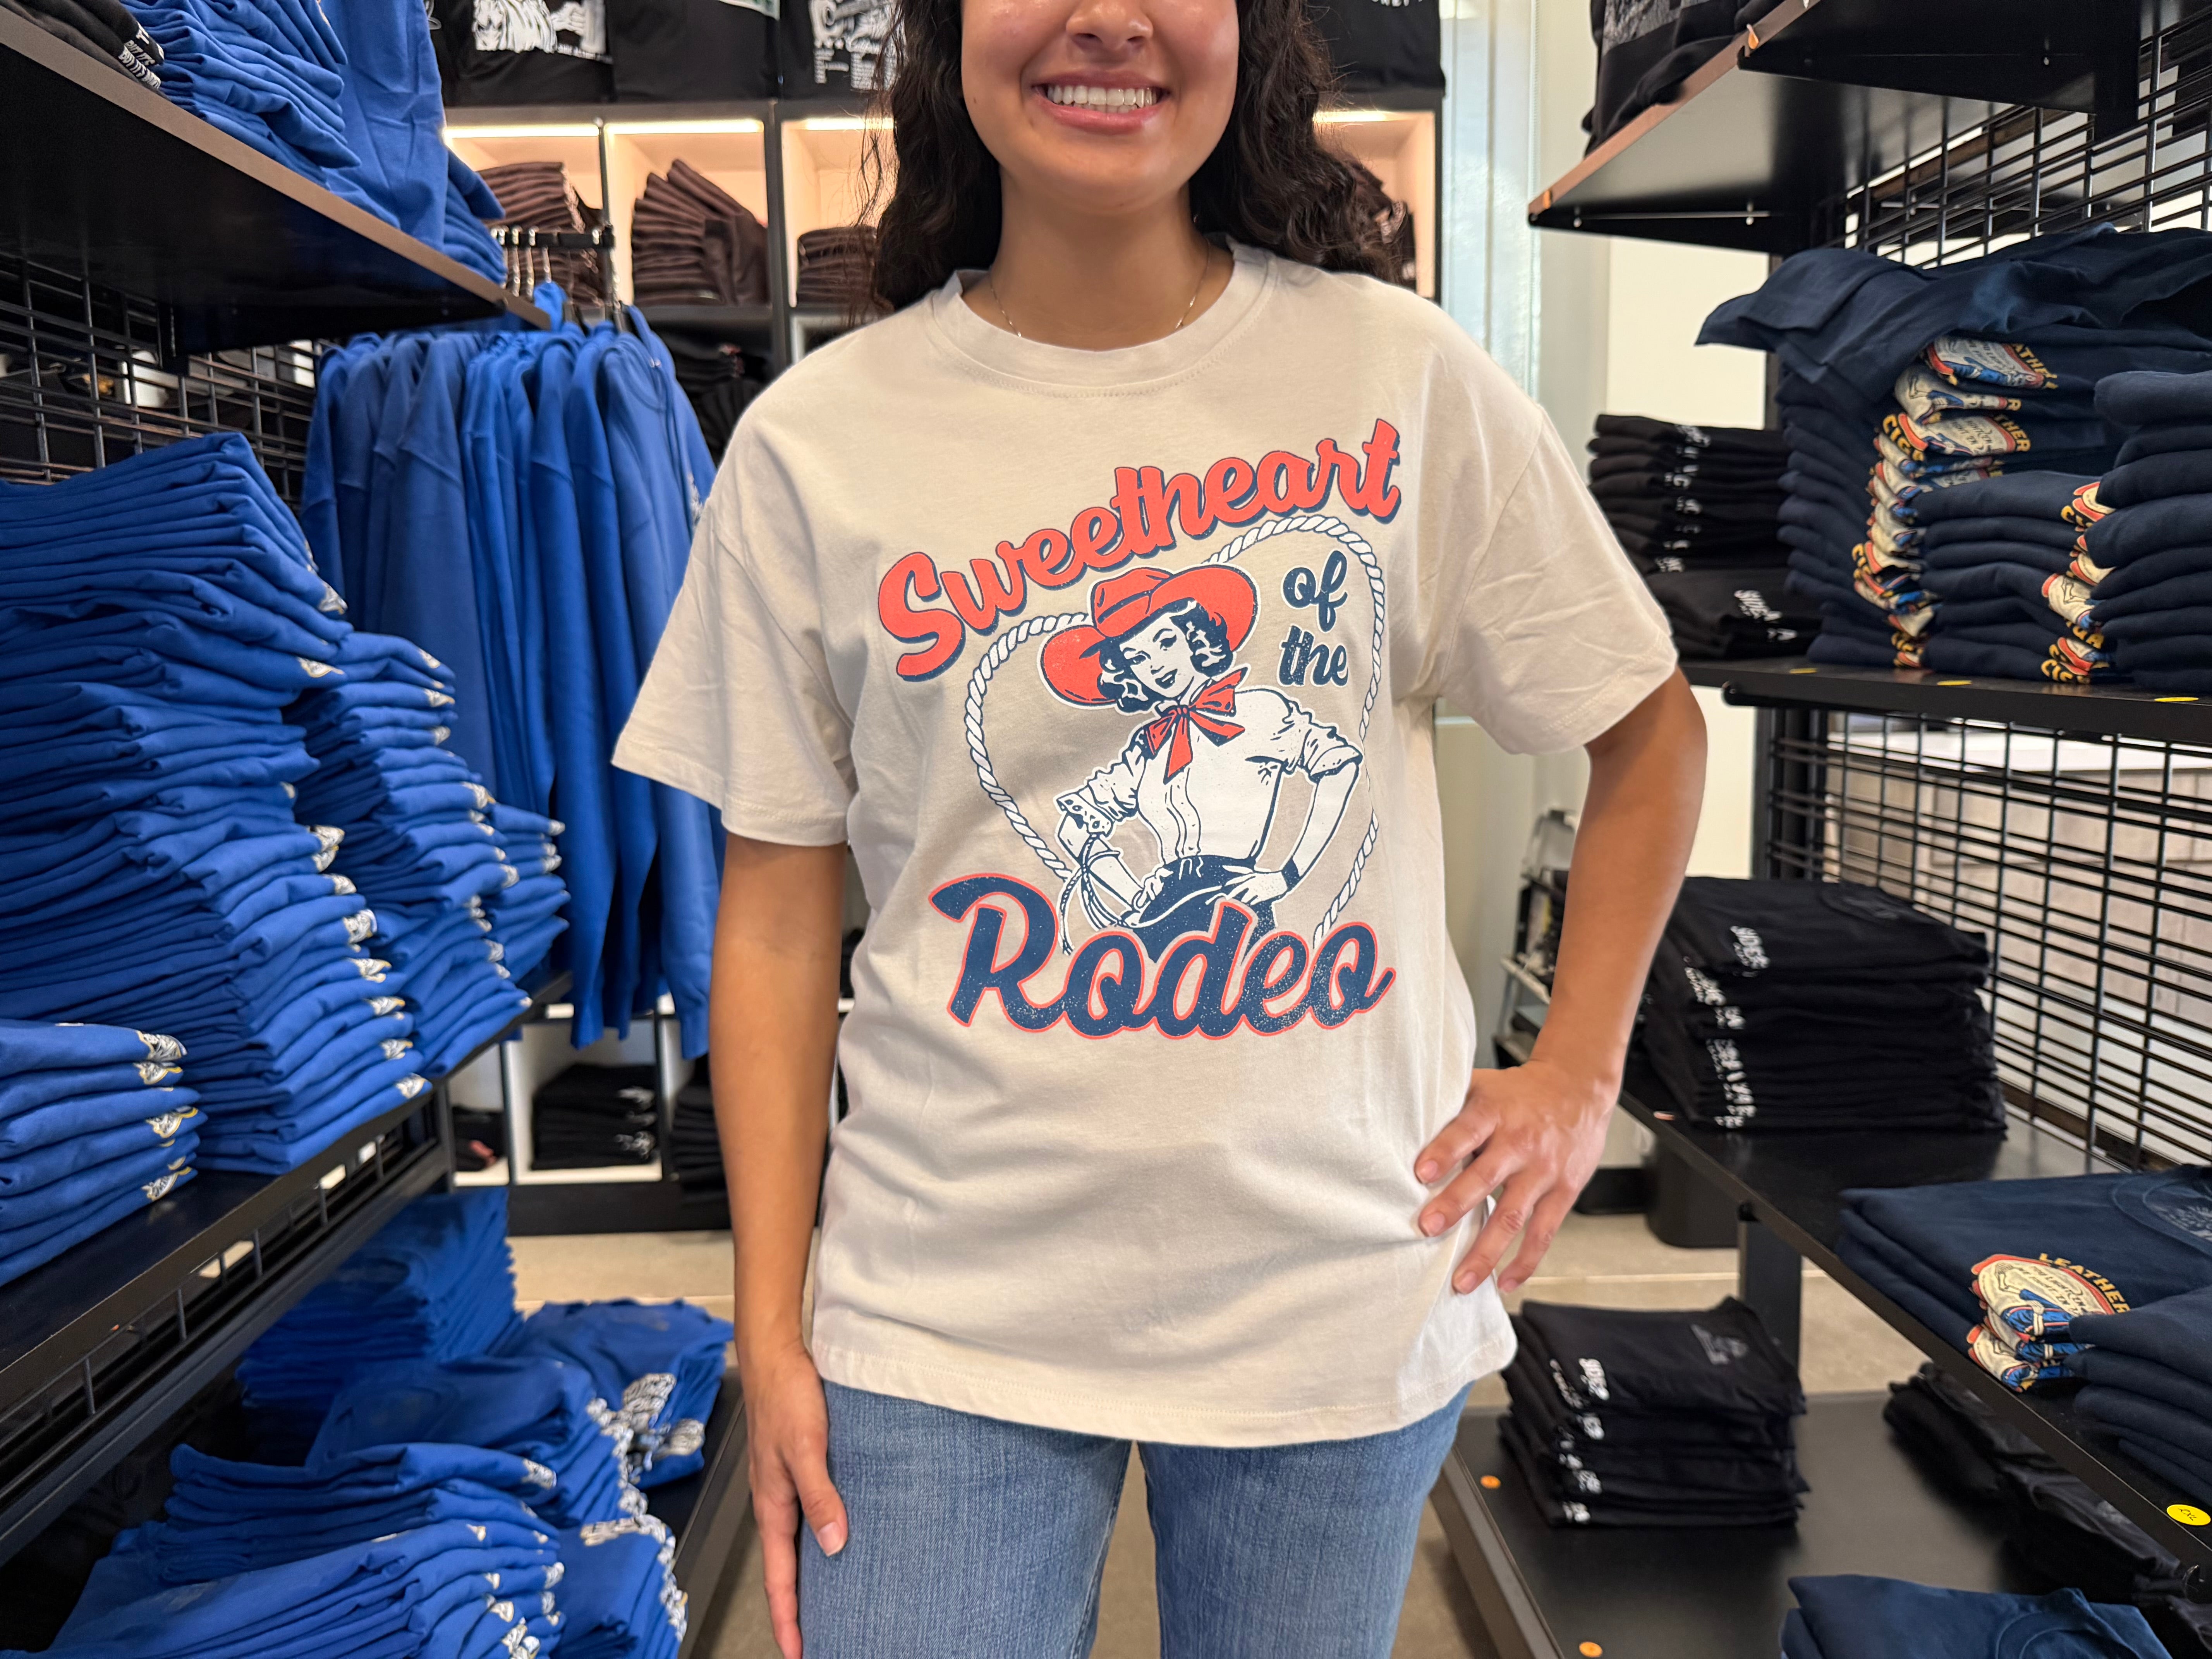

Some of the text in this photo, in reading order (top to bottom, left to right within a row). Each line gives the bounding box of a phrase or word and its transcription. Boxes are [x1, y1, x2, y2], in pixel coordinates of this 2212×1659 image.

[878, 418, 1402, 682] Sweetheart
[1281, 551, 1350, 631] of
[1280, 625, 1349, 688] the
[928, 872, 1397, 1040] Rodeo
